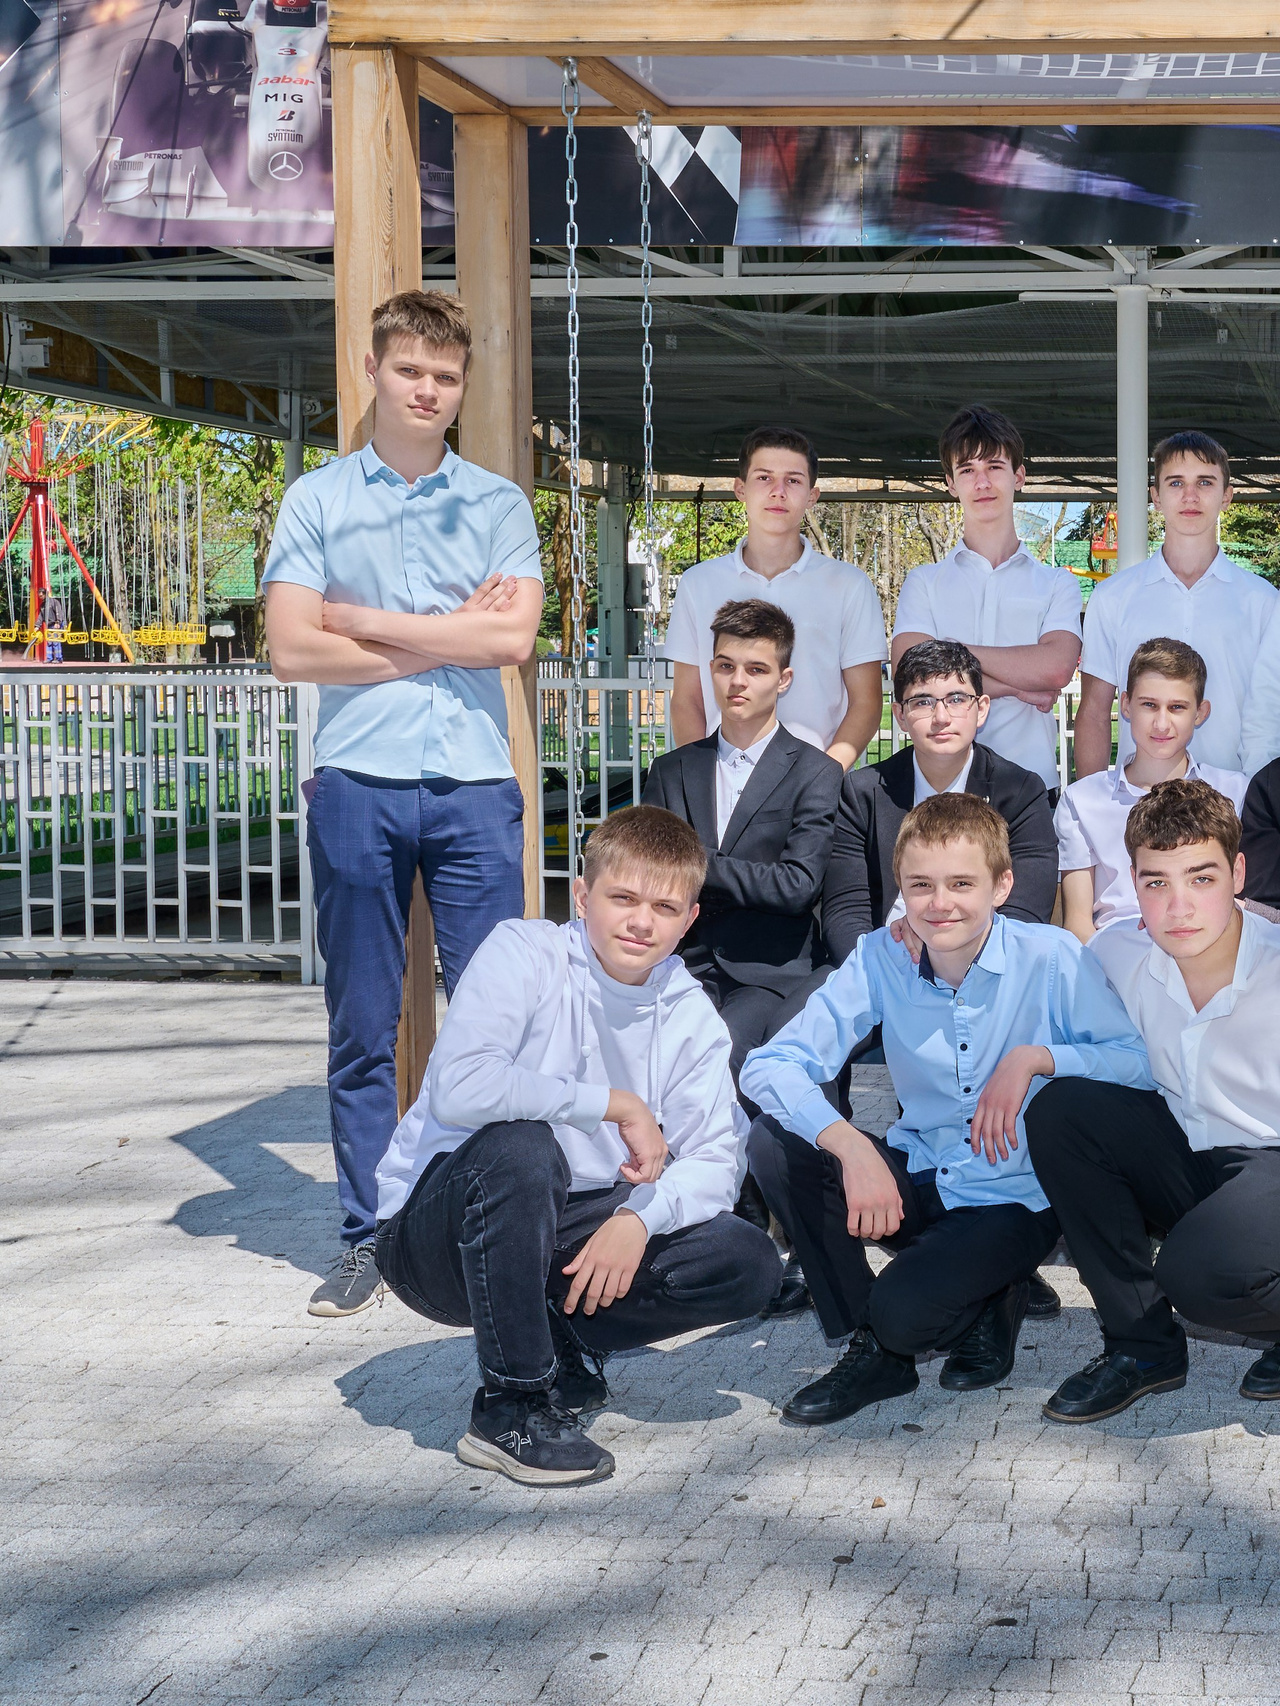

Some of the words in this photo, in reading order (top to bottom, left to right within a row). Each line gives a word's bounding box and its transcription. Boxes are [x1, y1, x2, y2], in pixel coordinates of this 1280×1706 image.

[278, 48, 297, 56] 3
[258, 75, 315, 86] aabar
[265, 93, 303, 103] MIG
[268, 132, 304, 143] SYNTIUM
[113, 161, 144, 171] SYNTIUM
